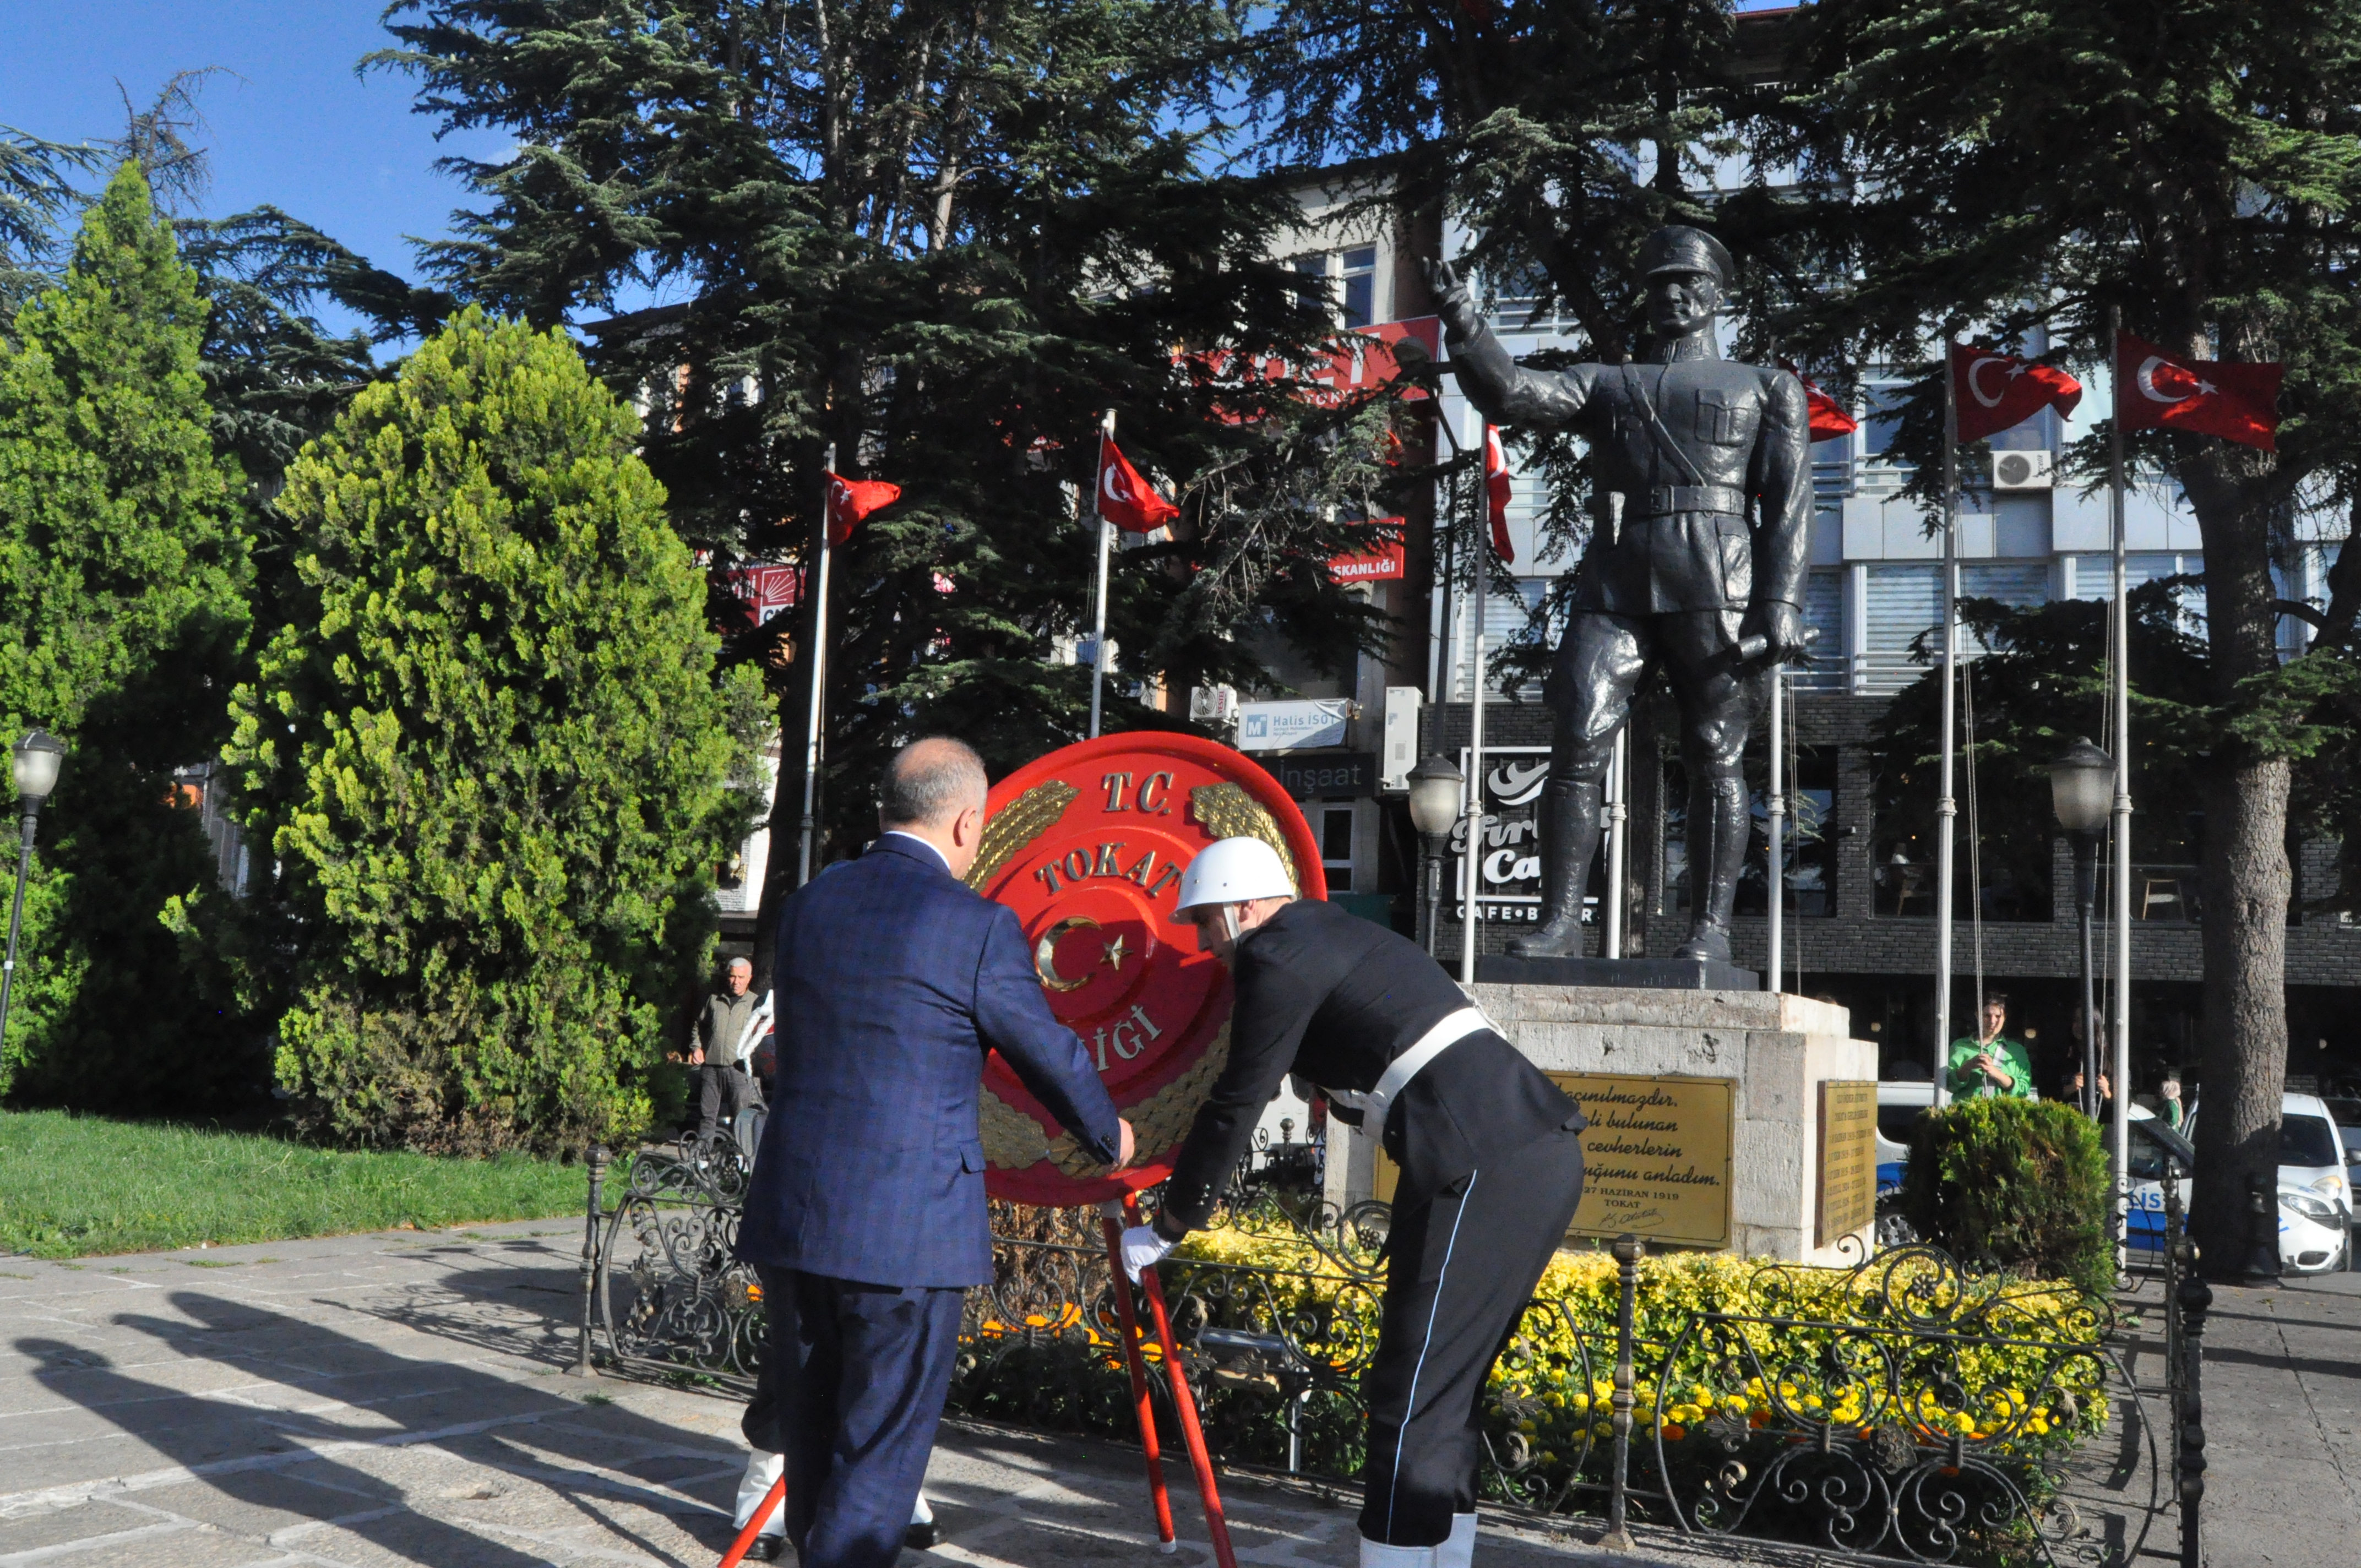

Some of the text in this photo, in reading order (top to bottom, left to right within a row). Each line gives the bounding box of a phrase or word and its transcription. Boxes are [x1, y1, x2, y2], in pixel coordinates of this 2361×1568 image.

[1329, 559, 1395, 580] ŞKANLIĞI
[1273, 716, 1304, 726] Halis
[1279, 759, 1361, 793] İnşaat
[1103, 771, 1174, 814] T.C.
[1037, 842, 1184, 897] TOKAT
[1558, 1082, 1678, 1111] açınılmazdır.
[1606, 1110, 1678, 1131] bulunan
[1587, 1136, 1683, 1157] cevherlerin
[1584, 1162, 1720, 1186] uğunu anladım.
[1604, 1199, 1641, 1208] TOKAT
[1653, 1191, 1679, 1200] 1919
